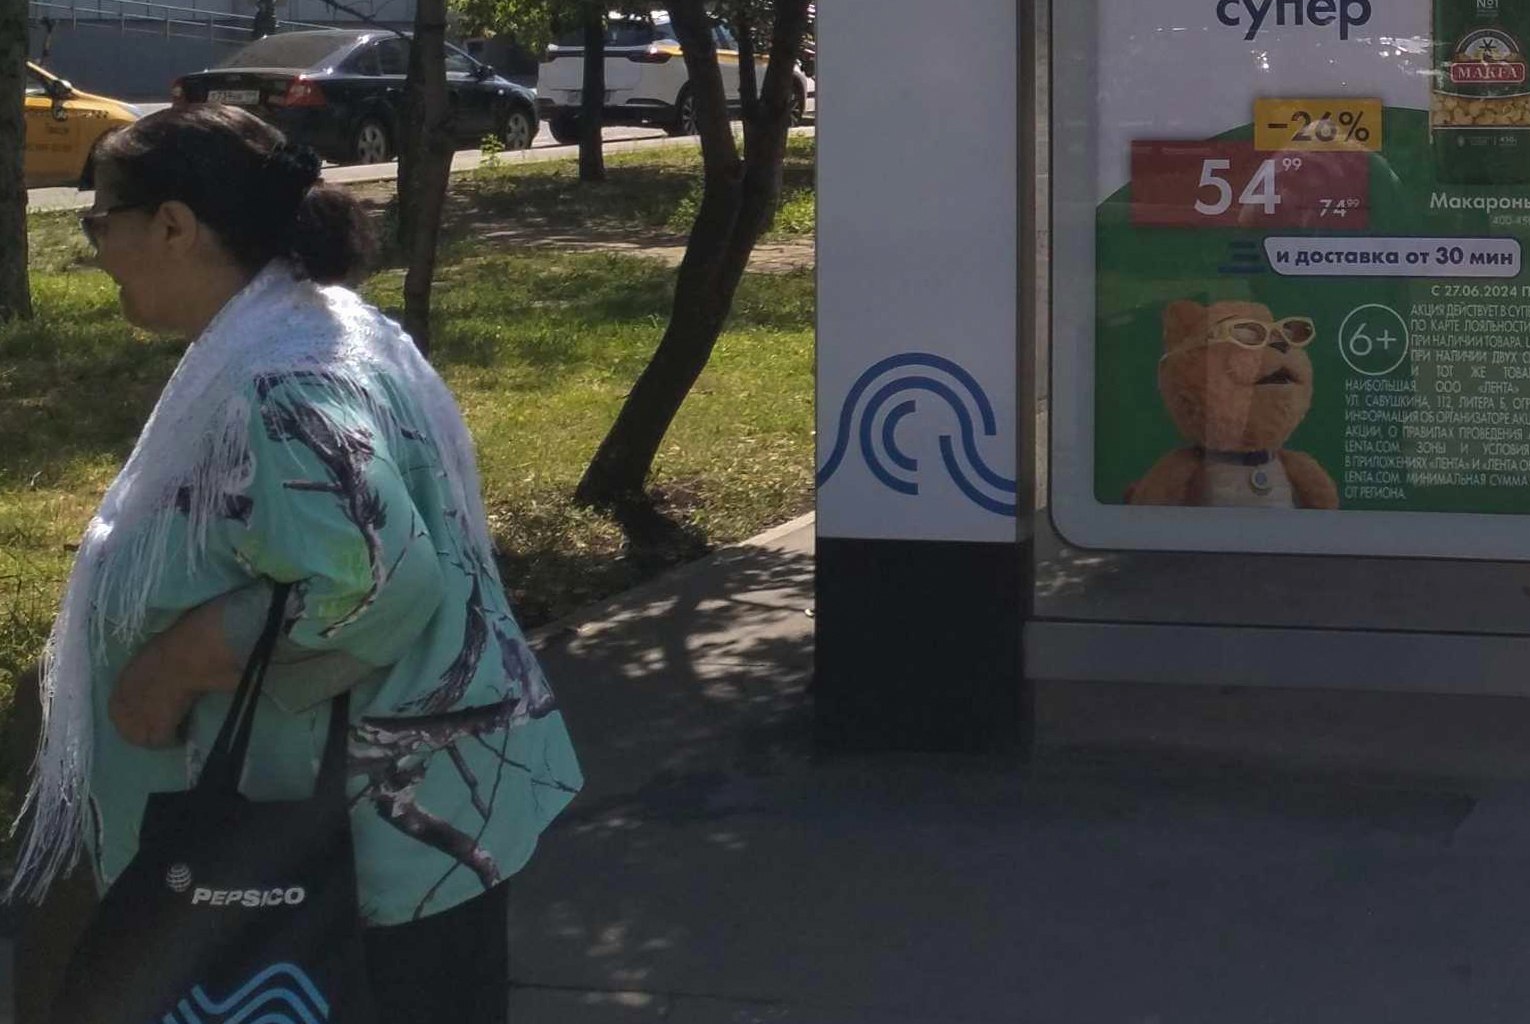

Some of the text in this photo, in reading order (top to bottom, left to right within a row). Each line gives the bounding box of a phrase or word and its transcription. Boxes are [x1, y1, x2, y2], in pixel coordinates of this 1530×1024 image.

[1193, 157, 1303, 216] 54 99
[1275, 246, 1514, 267] и доставка от 30 мин
[1430, 284, 1441, 297] С
[1444, 285, 1518, 298] 27.06.2024
[1410, 304, 1444, 318] АКЦИЯ
[1445, 301, 1499, 318] ДЕЙСТВУЕТ
[1410, 318, 1426, 331] ПО
[1430, 319, 1460, 332] КАРТЕ
[1348, 322, 1398, 356] 6+
[1435, 380, 1461, 393] ООО
[191, 886, 305, 907] PEPSICO
